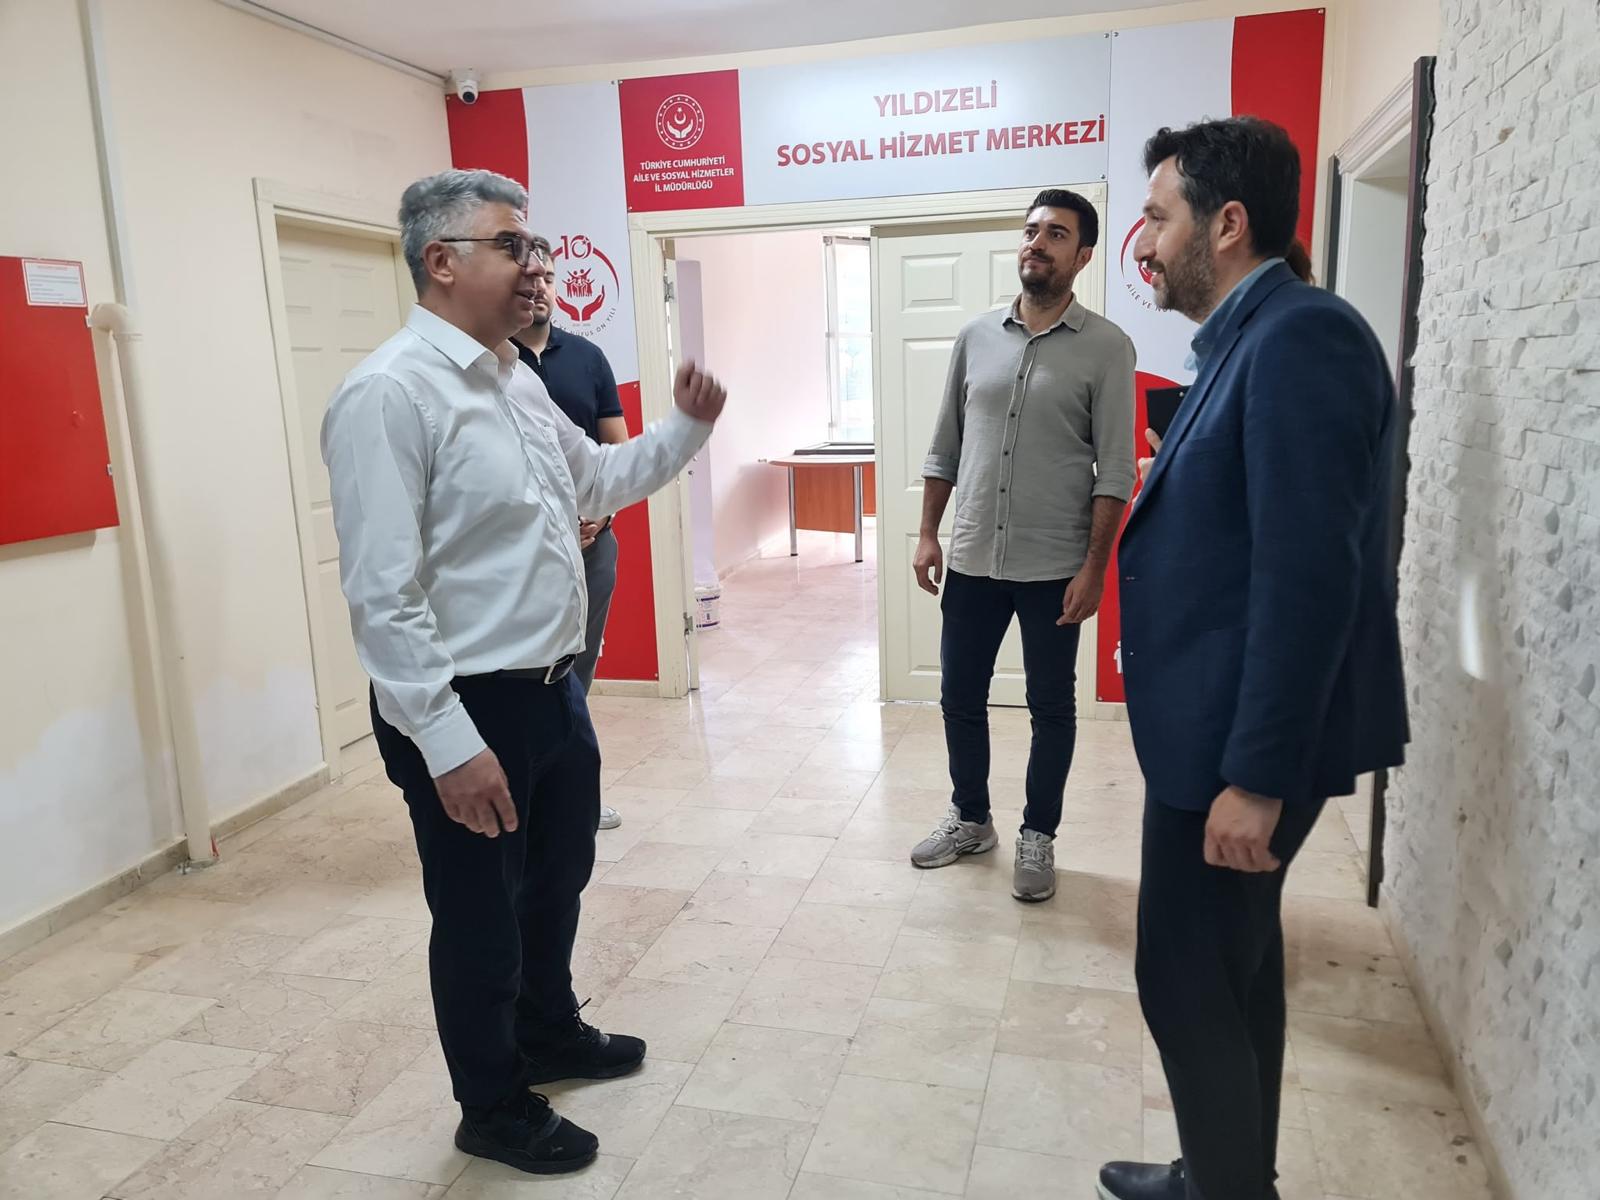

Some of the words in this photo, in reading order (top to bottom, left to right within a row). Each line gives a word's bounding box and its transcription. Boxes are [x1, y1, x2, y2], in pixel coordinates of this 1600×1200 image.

[873, 79, 997, 117] YILDIZELİ
[777, 139, 873, 167] SOSYAL
[879, 130, 980, 160] HİZMET
[986, 113, 1105, 151] MERKEZİ
[640, 159, 672, 171] TÜRKİYE
[672, 155, 726, 168] CUMHURİYETİ
[633, 173, 650, 183] AİLE
[650, 173, 660, 182] VE
[661, 170, 690, 181] SOSYAL
[691, 167, 735, 178] HİZMETLER
[654, 183, 662, 193] İL
[663, 179, 713, 192] MÜDÜRLÜĞÜ
[560, 235, 592, 259] 10
